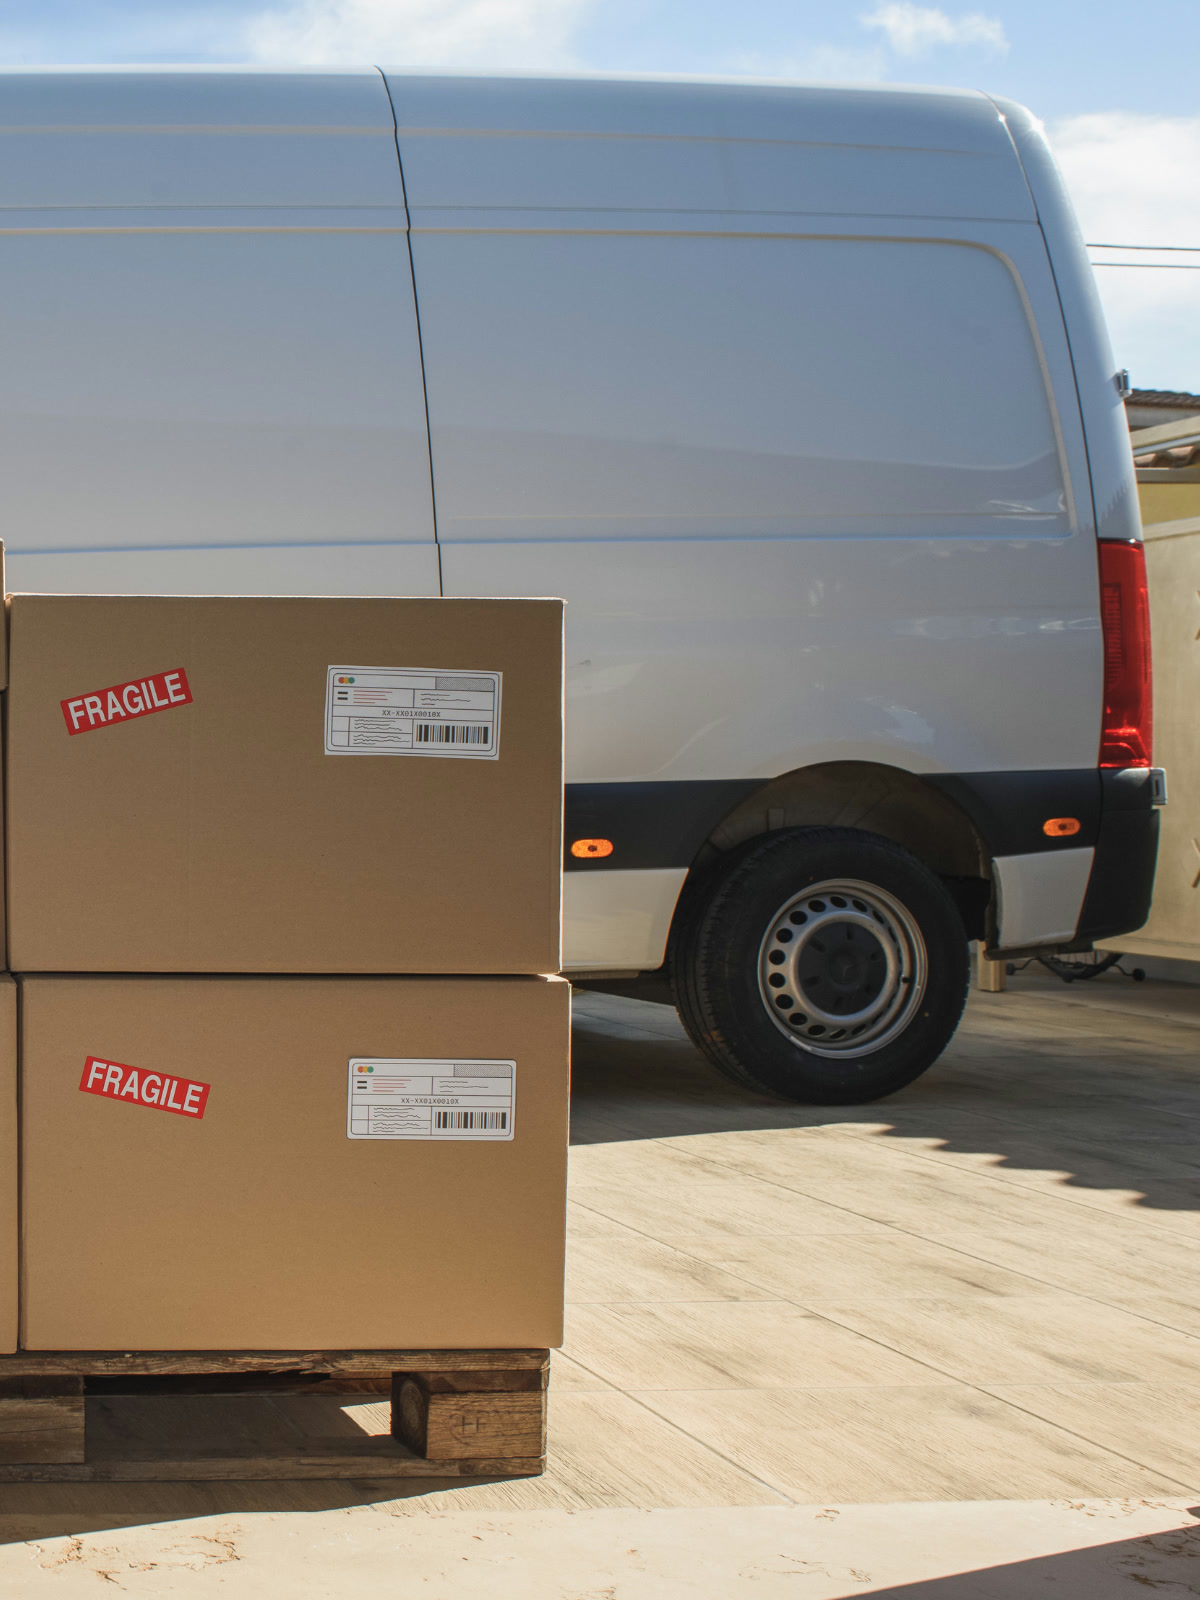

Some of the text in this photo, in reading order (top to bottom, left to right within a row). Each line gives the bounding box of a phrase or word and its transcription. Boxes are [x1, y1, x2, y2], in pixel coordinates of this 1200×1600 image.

[67, 672, 186, 730] FRAGILE
[381, 709, 441, 718] XX-XX01X0010X
[86, 1060, 204, 1114] FRAGILE
[401, 1097, 460, 1105] XX-XX01X0010X
